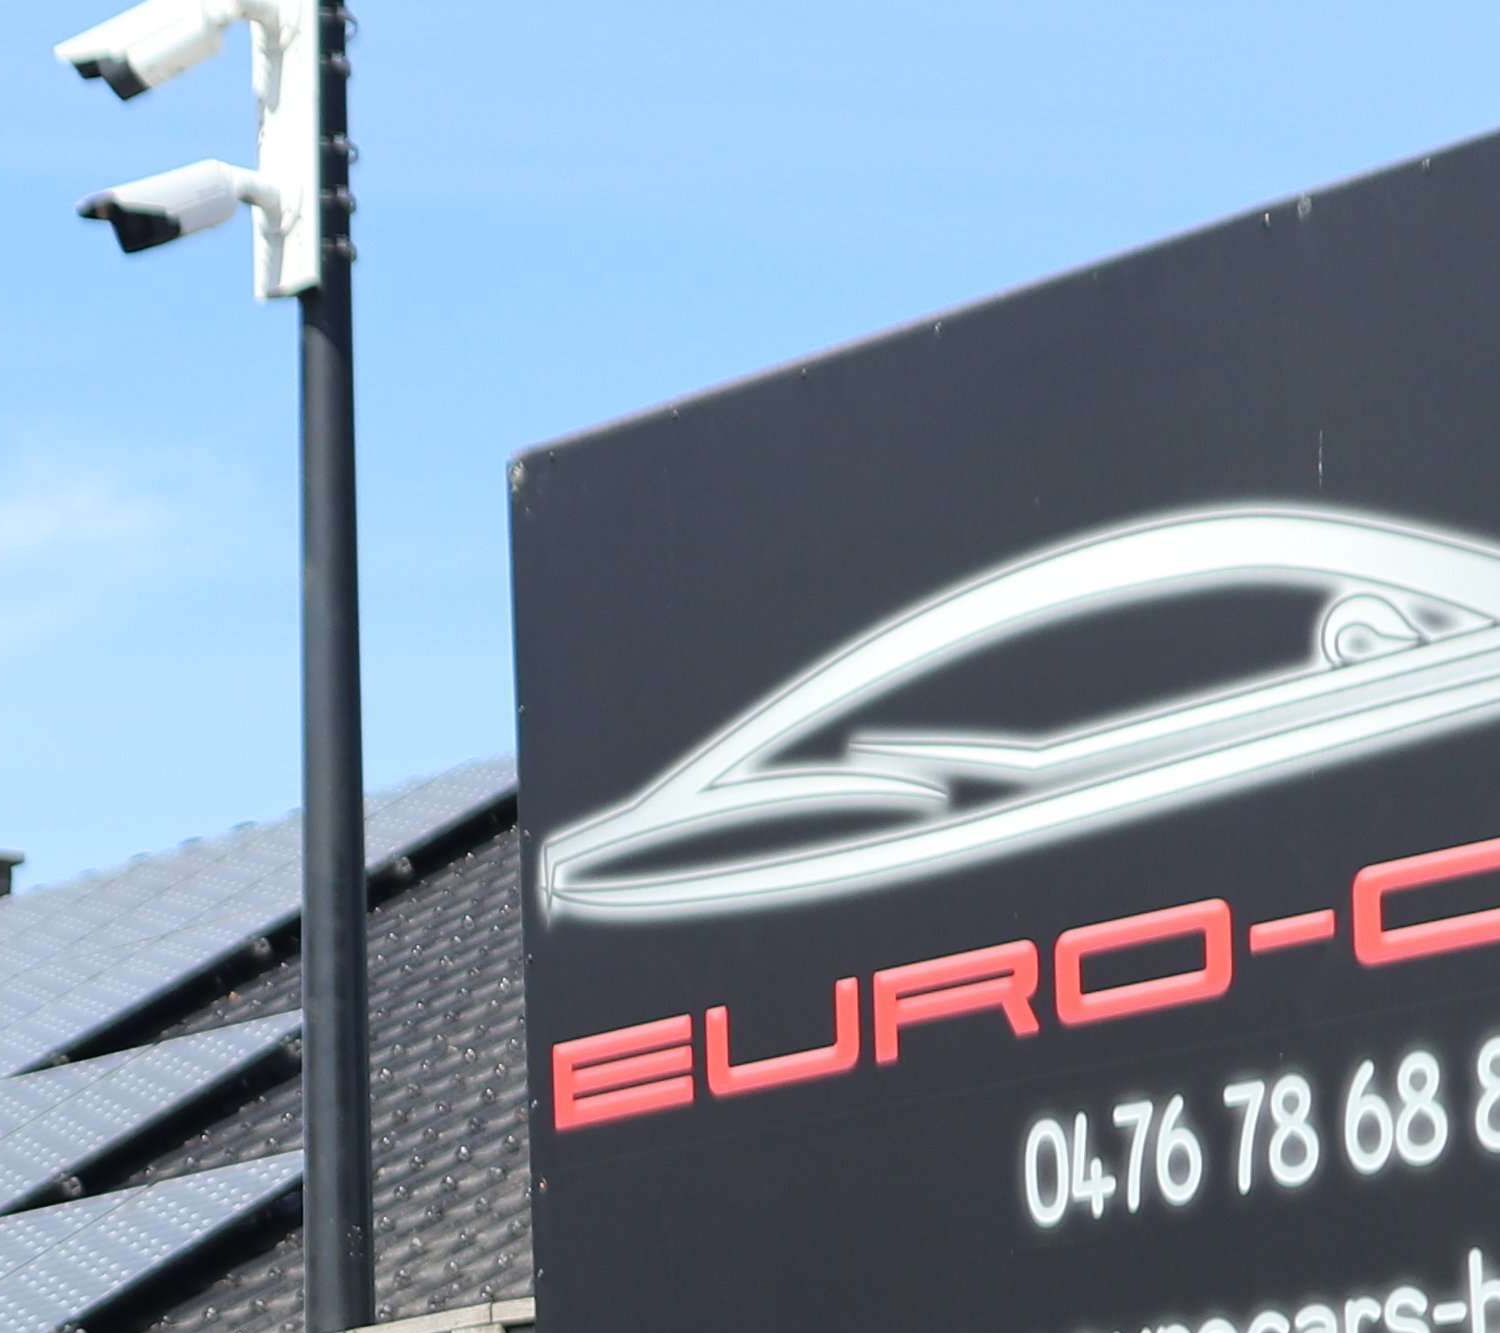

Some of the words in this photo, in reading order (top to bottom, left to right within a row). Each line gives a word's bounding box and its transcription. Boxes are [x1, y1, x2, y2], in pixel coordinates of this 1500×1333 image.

[1024, 1094, 1203, 1229] 0476
[1222, 1073, 1320, 1195] 78
[1343, 1050, 1449, 1175] 68
